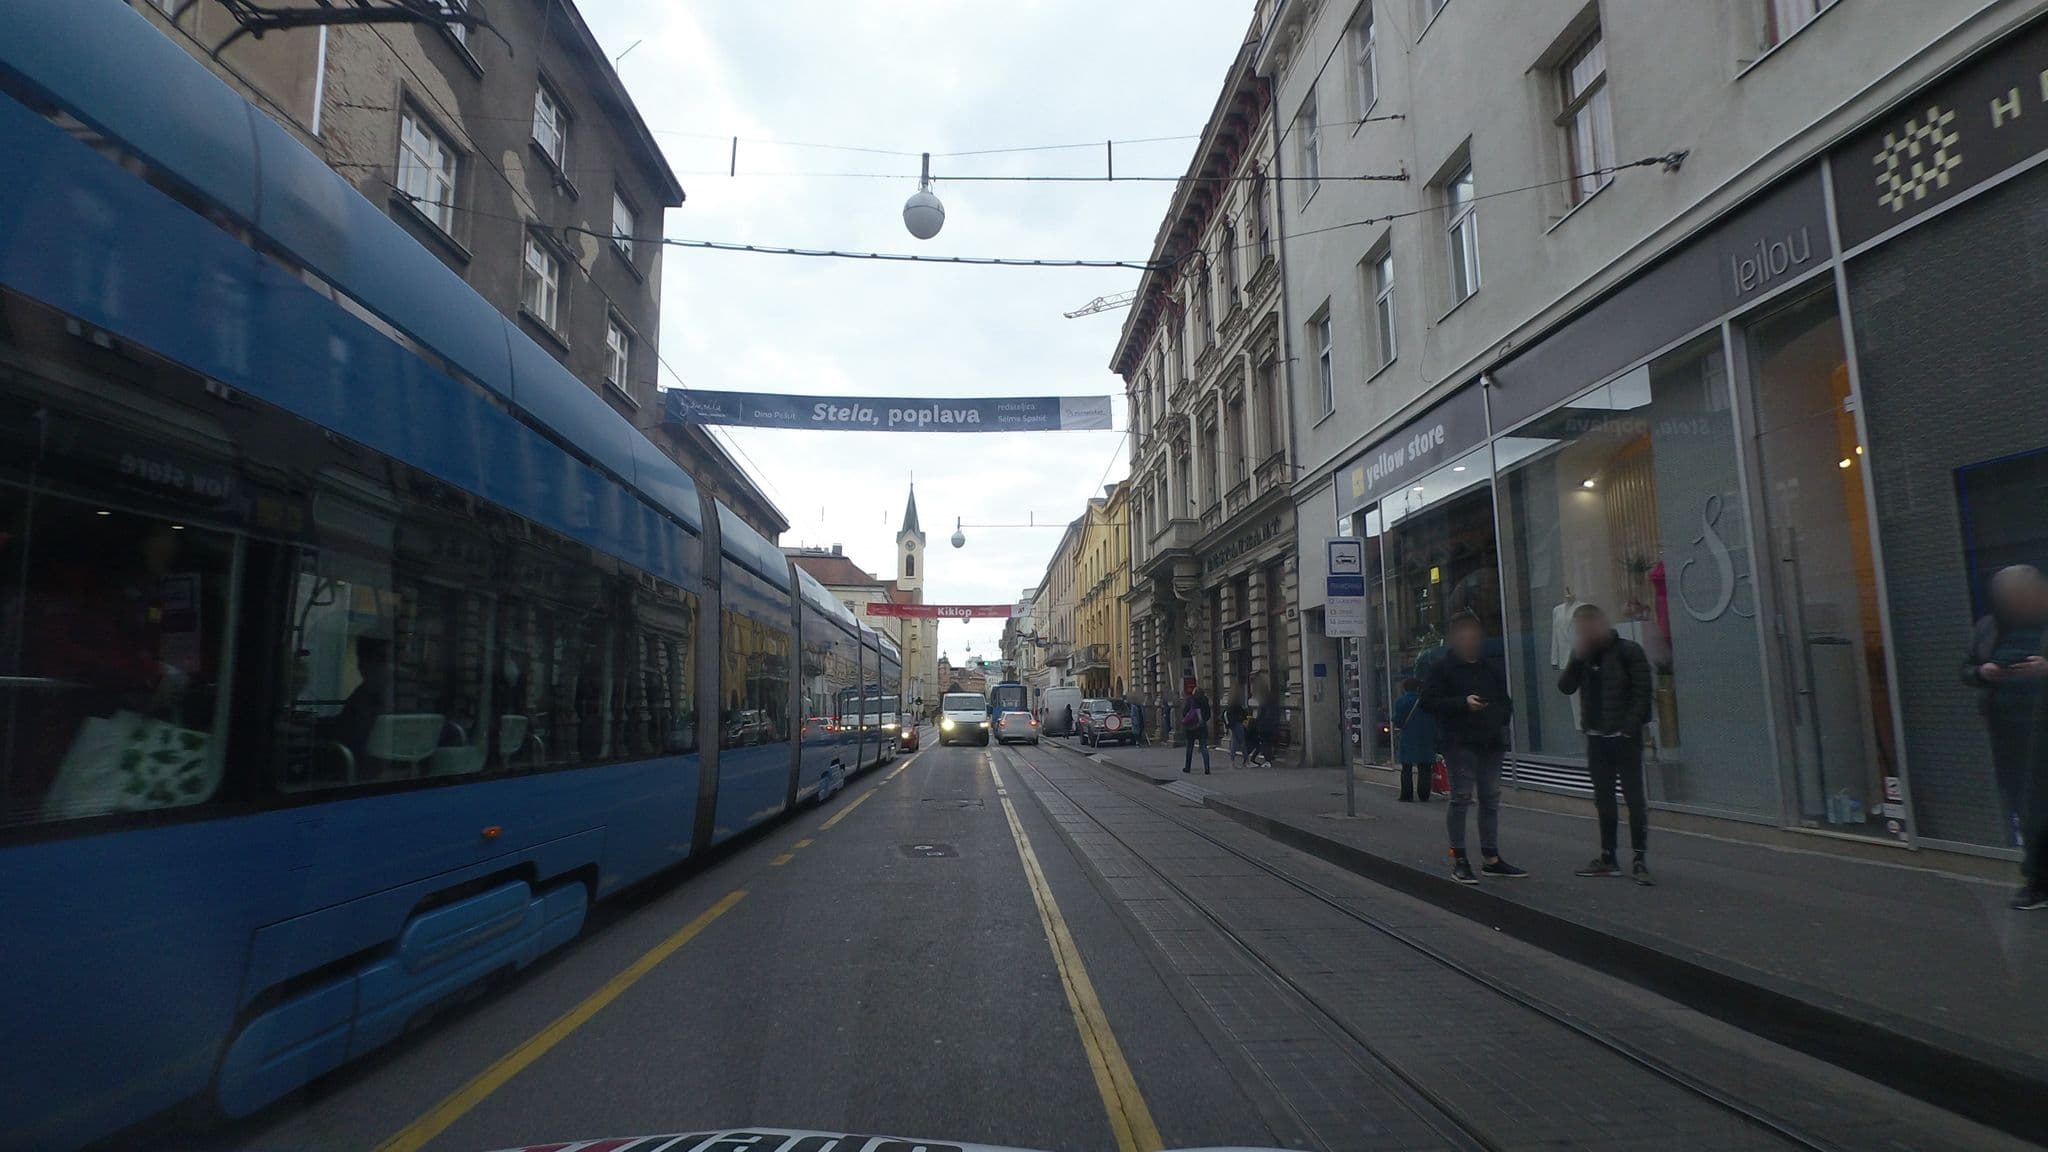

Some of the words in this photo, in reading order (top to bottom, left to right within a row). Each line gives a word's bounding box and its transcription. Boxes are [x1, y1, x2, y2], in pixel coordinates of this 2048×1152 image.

[1990, 68, 2048, 129] H
[1731, 227, 1812, 297] leilou
[811, 403, 879, 425] Stela,
[888, 404, 980, 427] poplava
[1366, 447, 1405, 491] yellow
[1407, 423, 1445, 462] store
[937, 607, 973, 617] Kiklop
